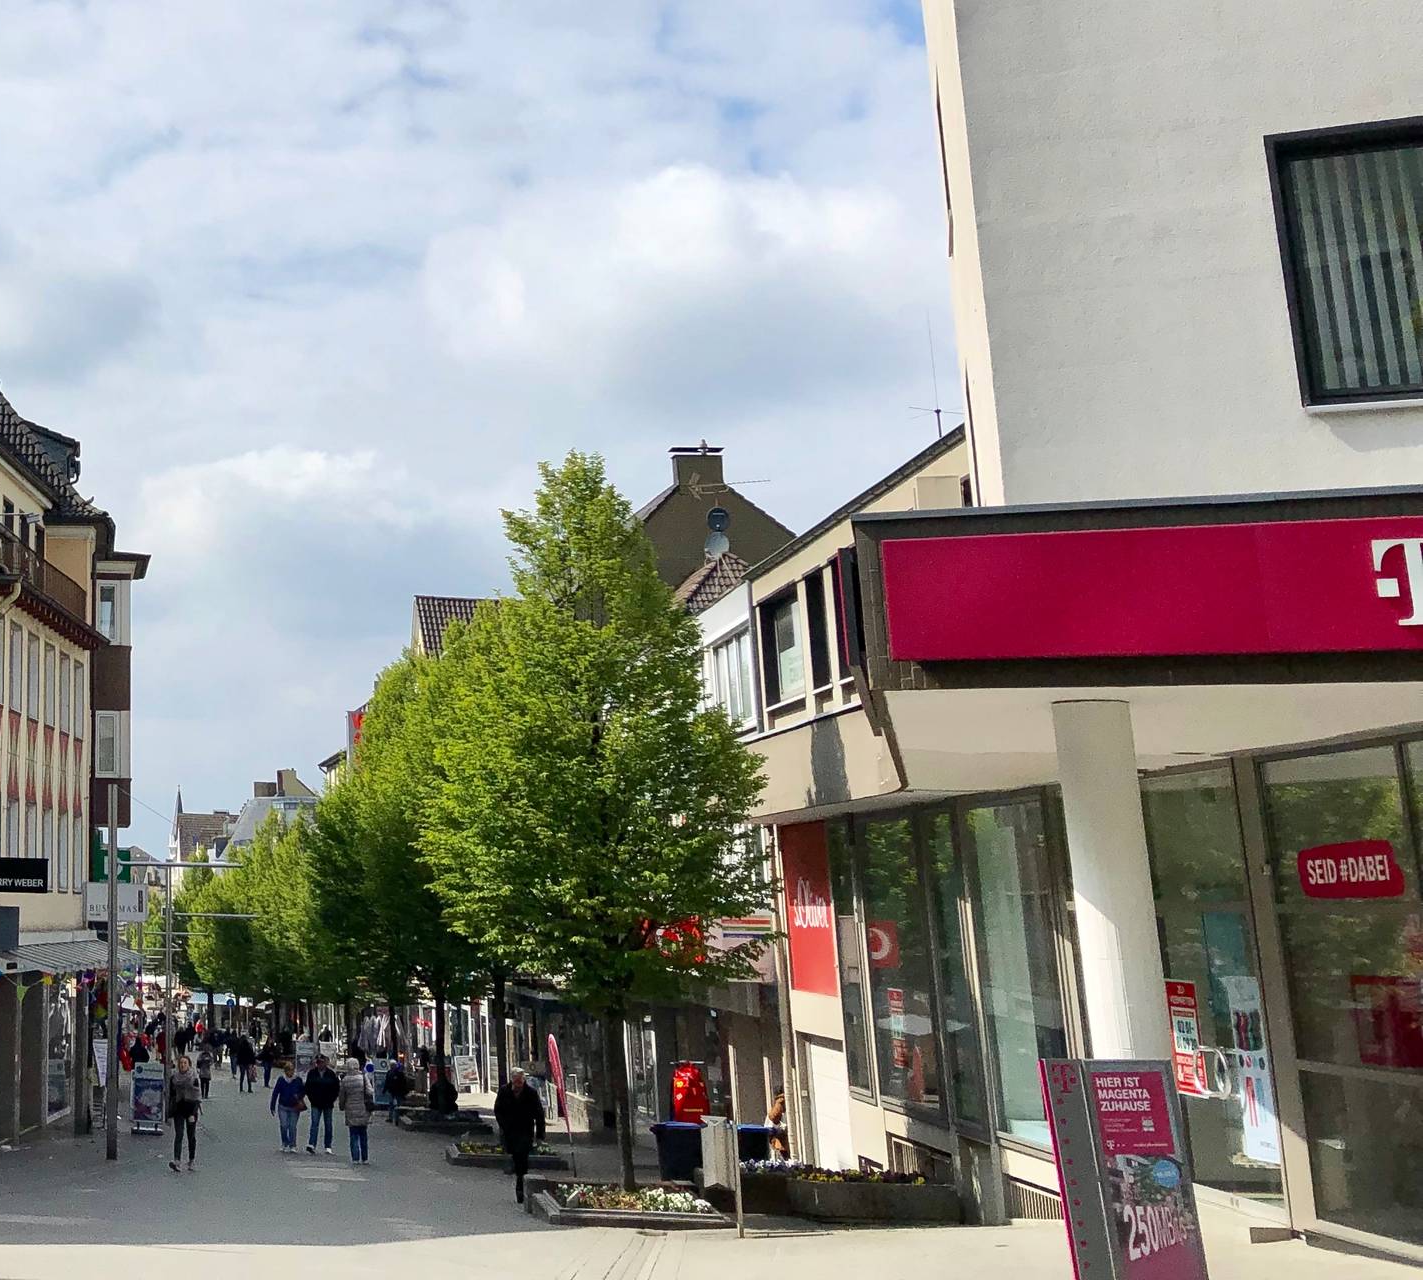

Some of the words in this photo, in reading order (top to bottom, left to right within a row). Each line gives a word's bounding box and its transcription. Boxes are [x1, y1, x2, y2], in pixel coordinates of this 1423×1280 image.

[1307, 858, 1337, 885] SEID
[1339, 854, 1391, 883] #DABEI
[14, 878, 44, 888] WEBER
[89, 904, 138, 913] BUSMAS
[1095, 1077, 1122, 1088] HIER
[1124, 1077, 1140, 1087] IST
[1098, 1088, 1151, 1100] MAGENTA
[1100, 1101, 1152, 1112] ZUHAUSE
